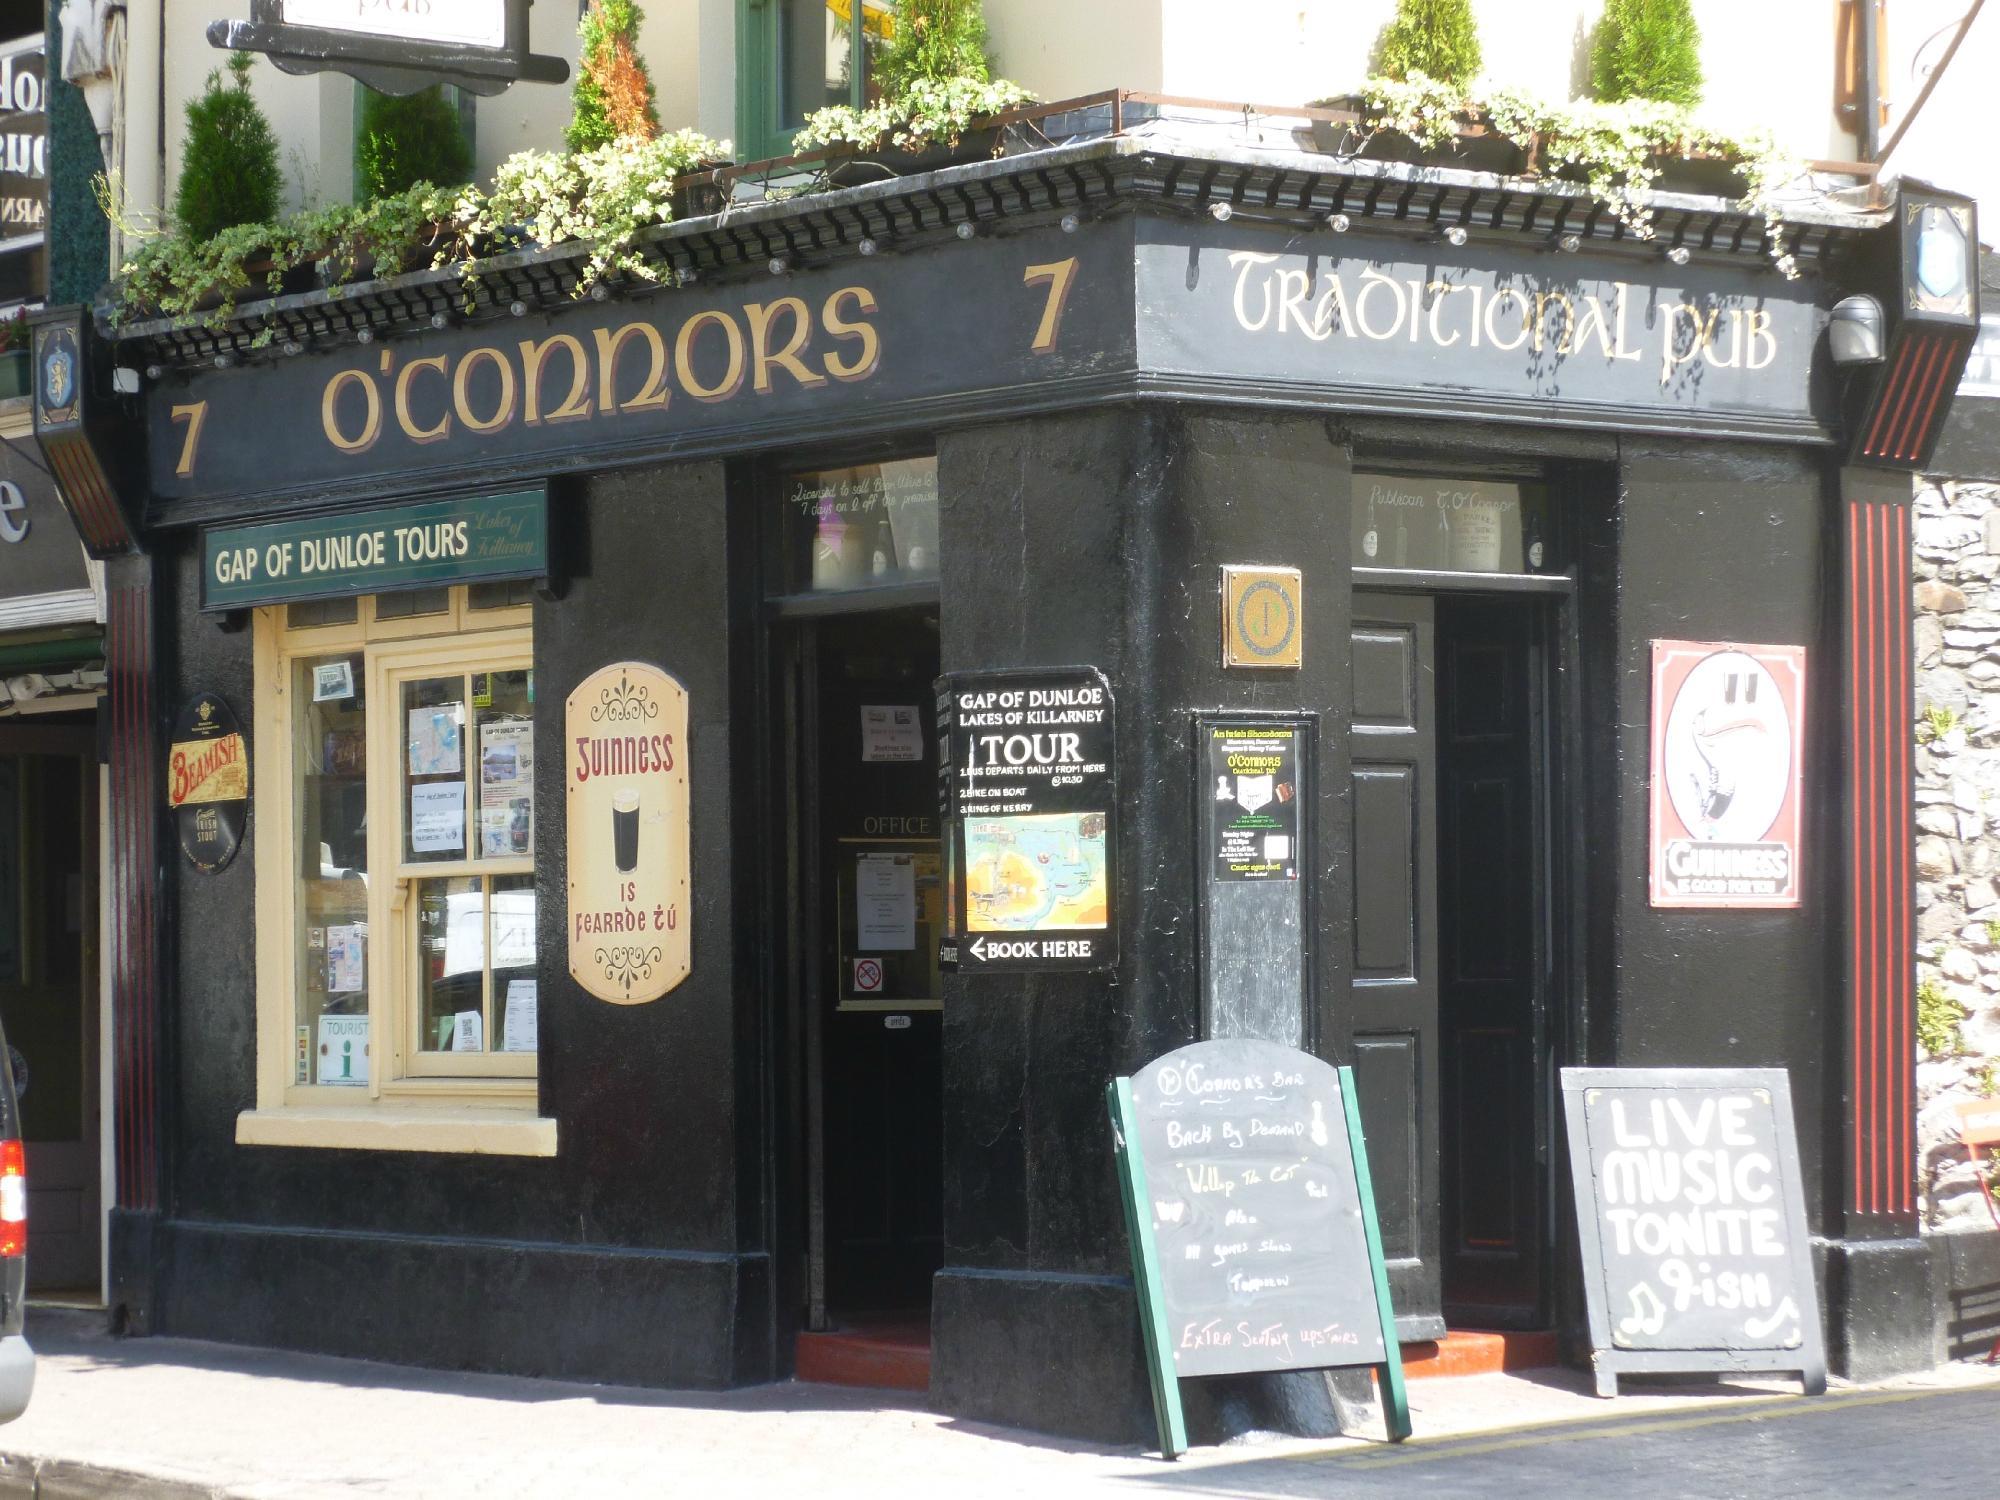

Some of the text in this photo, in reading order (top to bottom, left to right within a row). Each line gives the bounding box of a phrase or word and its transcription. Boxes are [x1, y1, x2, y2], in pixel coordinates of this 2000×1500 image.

[1023, 257, 1079, 355] 7
[171, 400, 208, 478] 7
[840, 480, 849, 496] to
[801, 502, 808, 516] 7
[811, 503, 833, 521] days
[836, 502, 848, 513] on
[215, 521, 468, 584] GAP OF DUNLOE TOURS
[959, 688, 1103, 710] GAP OF DUNLOE
[959, 709, 1104, 727] LAKES OF KILLARNEY
[979, 732, 1084, 765] TOUR
[172, 733, 239, 803] BEAMISH
[985, 765, 1024, 776] DEPARTS
[1055, 764, 1081, 774] FROM
[1083, 763, 1106, 773] HERE
[987, 788, 1001, 798] ON
[1002, 787, 1027, 797] BOAT
[990, 803, 1001, 813] OF
[1002, 803, 1033, 813] KERRY
[864, 816, 929, 834] OFFICE
[1668, 841, 1788, 879] GUINNESS
[987, 940, 1091, 959] BOOK HERE
[327, 1022, 369, 1036] TOURIST
[1610, 1097, 1757, 1148] LIVE
[1601, 1149, 1775, 1205] MUSIC
[1605, 1206, 1786, 1256] TONITE
